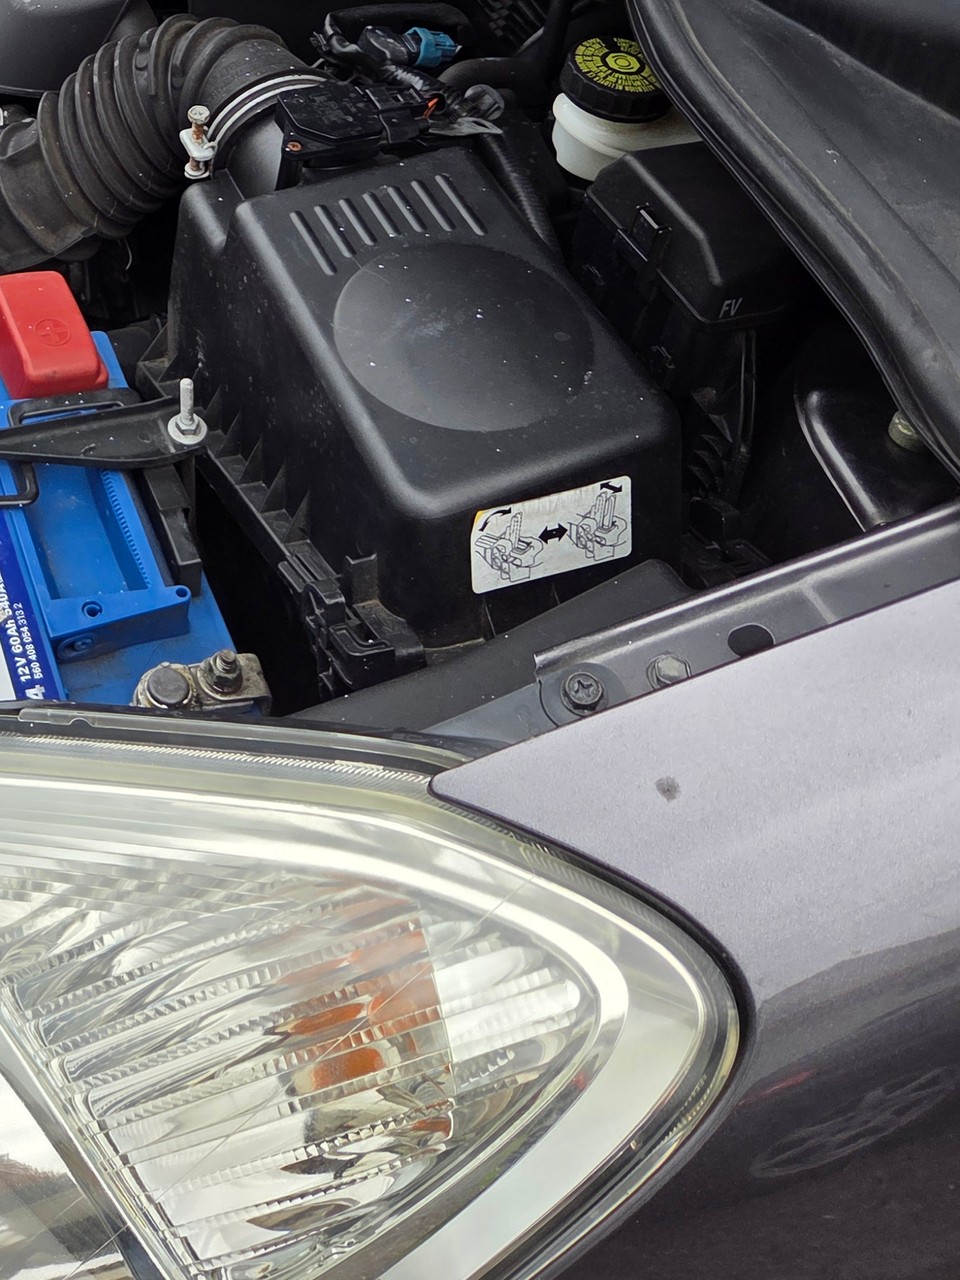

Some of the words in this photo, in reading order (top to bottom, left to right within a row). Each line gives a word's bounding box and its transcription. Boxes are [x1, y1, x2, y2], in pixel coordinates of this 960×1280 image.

[719, 297, 743, 318] FV
[12, 602, 24, 610] 2
[14, 609, 28, 626] 313
[5, 618, 23, 654] 60Ah
[21, 627, 33, 643] 054
[24, 643, 38, 661] 408
[14, 657, 32, 682] 12V
[31, 662, 44, 680] 560
